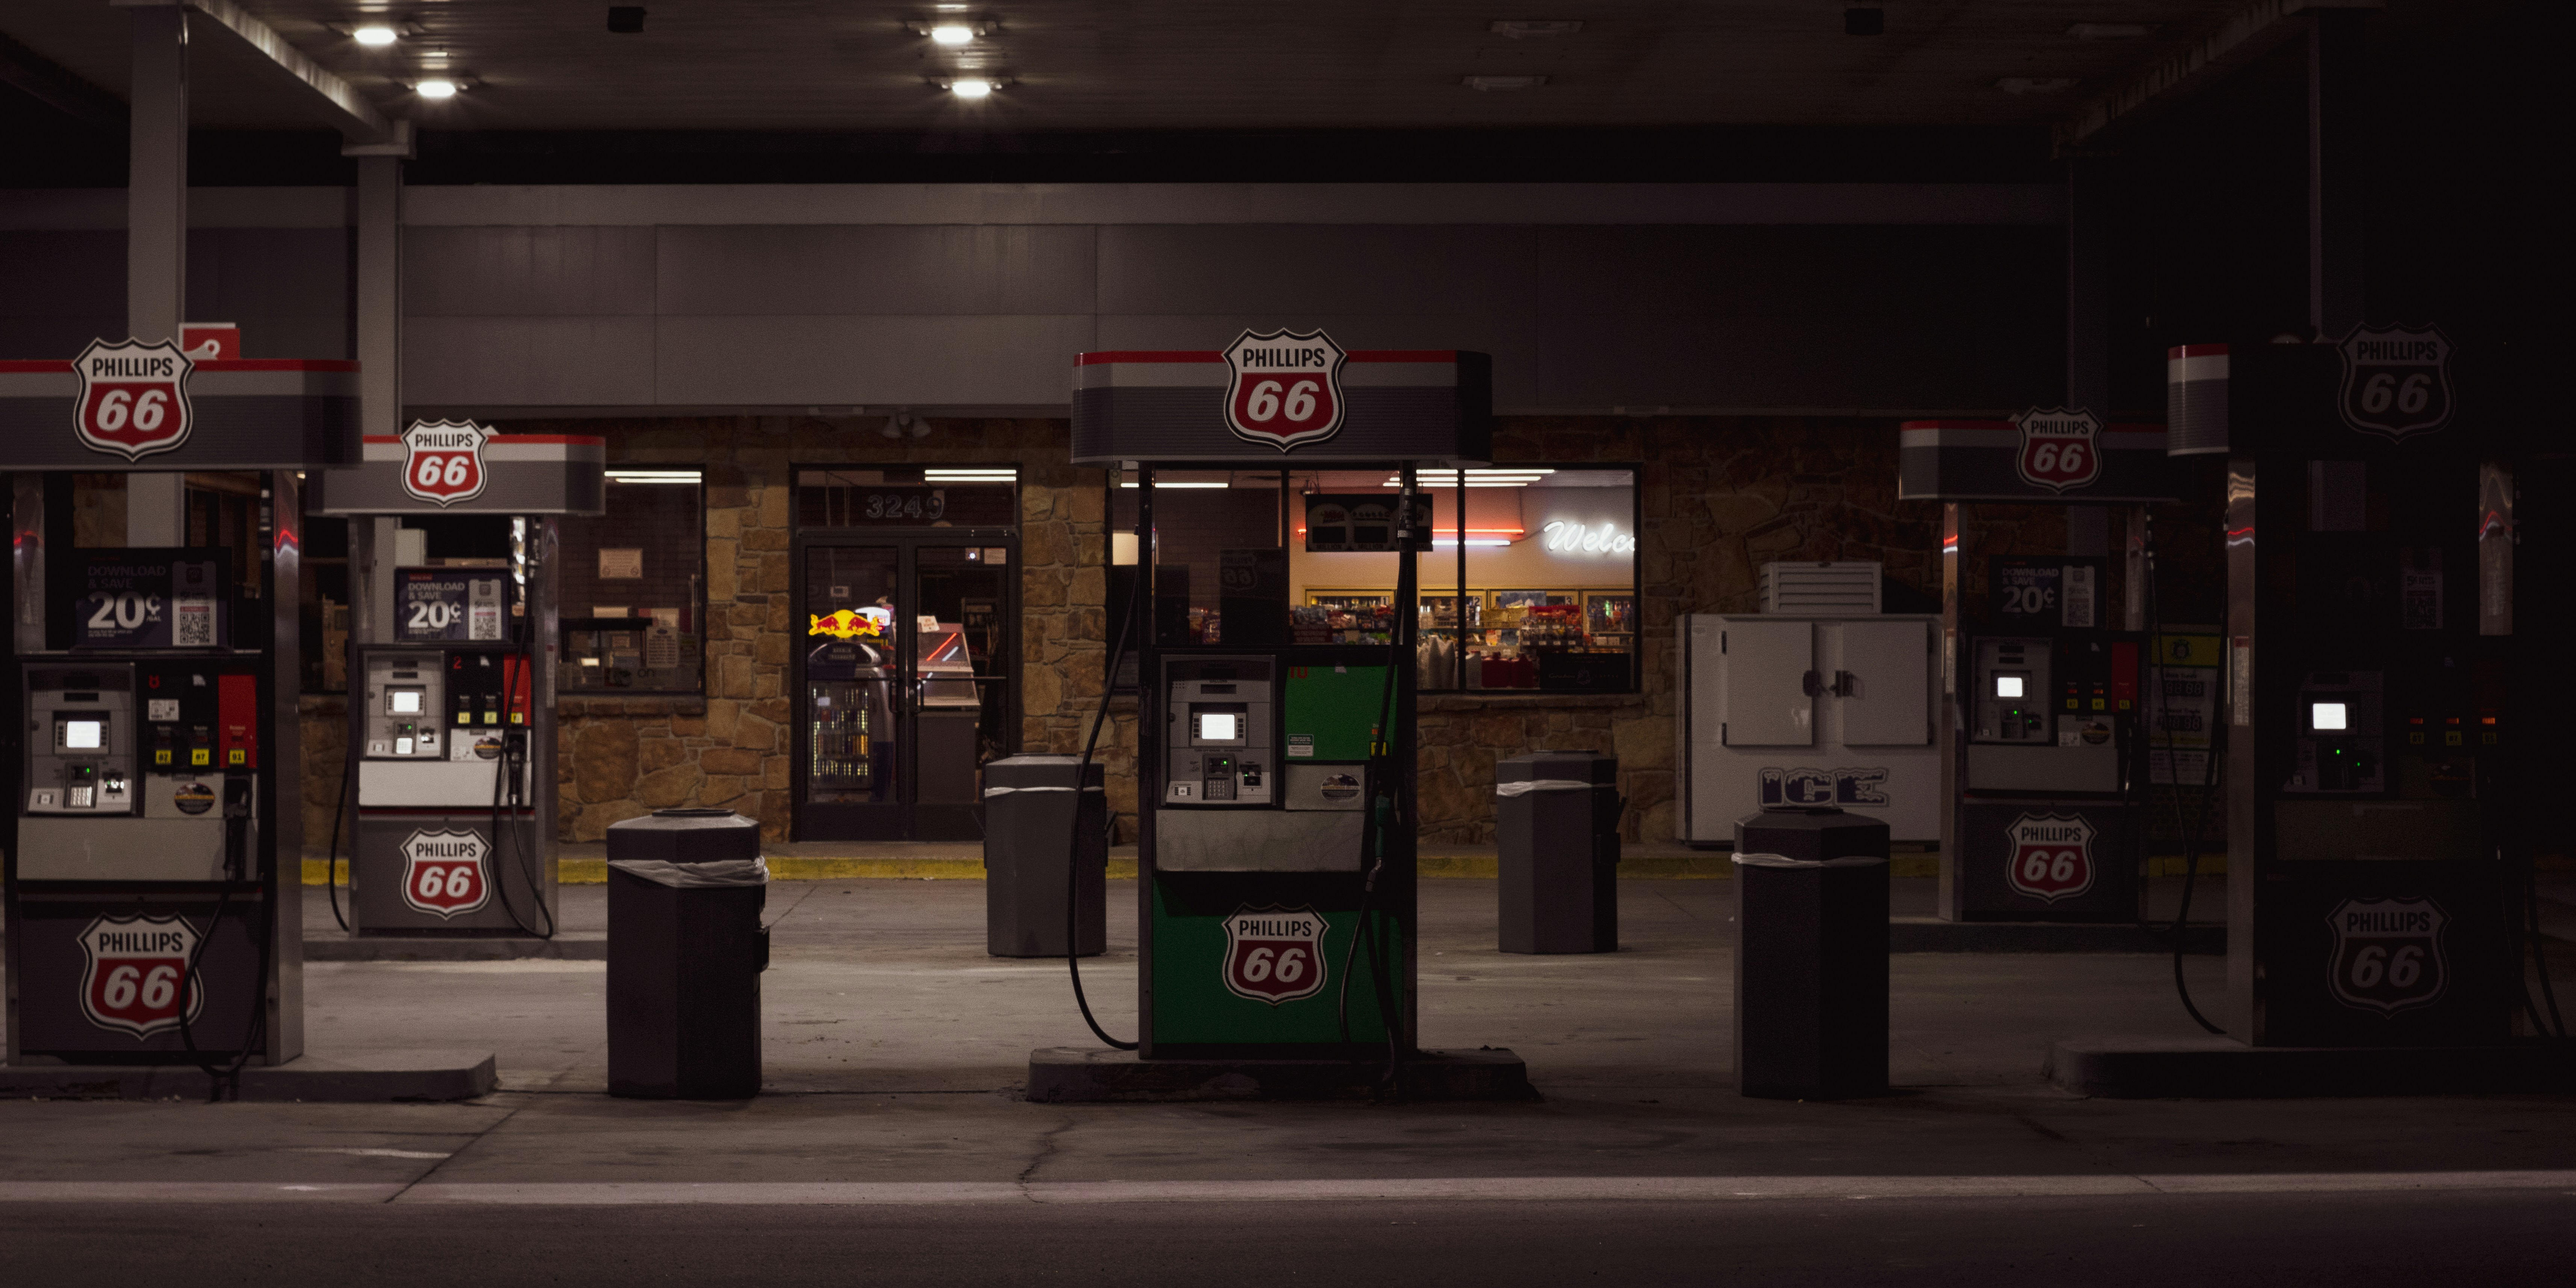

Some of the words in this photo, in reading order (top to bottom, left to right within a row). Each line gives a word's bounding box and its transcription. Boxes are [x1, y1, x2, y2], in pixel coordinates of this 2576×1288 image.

[1243, 348, 1325, 368] PHILLIPS
[2357, 341, 2438, 360] PHILLIPS
[92, 358, 173, 377] PHILLIPS
[1247, 379, 1319, 422] 66
[2361, 373, 2431, 414] 66
[96, 389, 168, 432] 66
[2031, 420, 2089, 434] PHILLIPS
[415, 433, 473, 448] PHILLIPS
[2033, 442, 2084, 474] 66
[417, 456, 469, 487] 66
[866, 494, 945, 520] 3249
[88, 566, 166, 577] DOWNLOAD
[2002, 568, 2059, 577] DOWNLOAD
[2002, 577, 2009, 585] &
[2011, 577, 2035, 585] SAVE
[88, 579, 97, 589] &
[101, 578, 133, 589] SAVE
[408, 582, 465, 591] DOWNLOAD
[418, 592, 442, 600] SAVE
[1474, 597, 1480, 606] 2
[453, 655, 462, 669] 2
[1759, 767, 1889, 807] ICE
[2021, 826, 2081, 842] PHILLIPS
[416, 843, 477, 857] PHILLIPS
[2023, 850, 2077, 883] 66
[418, 866, 473, 898] 66
[1239, 919, 1312, 937] PHILLIPS
[2347, 912, 2431, 932] PHILLIPS
[99, 932, 183, 952] PHILLIPS
[1243, 947, 1307, 983] 66
[2351, 945, 2425, 988] 66
[103, 964, 179, 1011] 66
